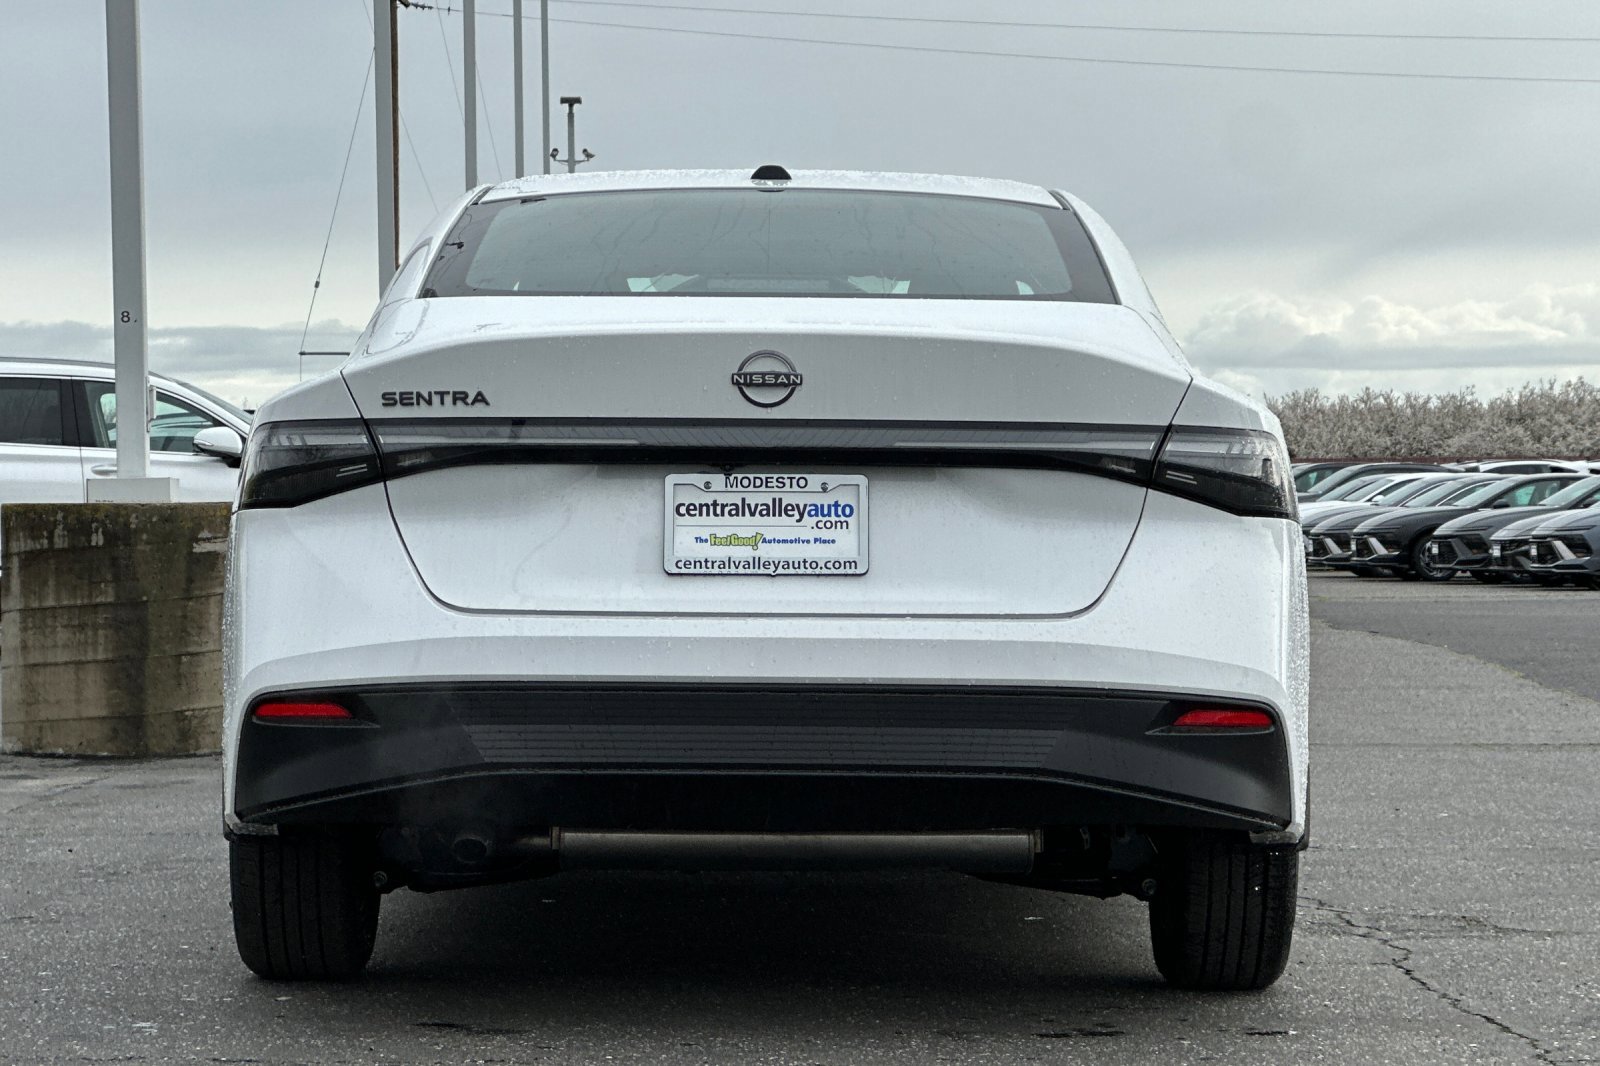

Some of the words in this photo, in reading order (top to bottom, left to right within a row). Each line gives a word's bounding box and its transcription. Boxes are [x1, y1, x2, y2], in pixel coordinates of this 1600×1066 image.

[733, 374, 801, 384] NISSAN
[381, 390, 491, 406] SENTRA
[724, 475, 808, 489] MODESTO
[811, 519, 849, 530] .com
[694, 536, 709, 544] The
[674, 556, 858, 573] centralvalleyauto.com
